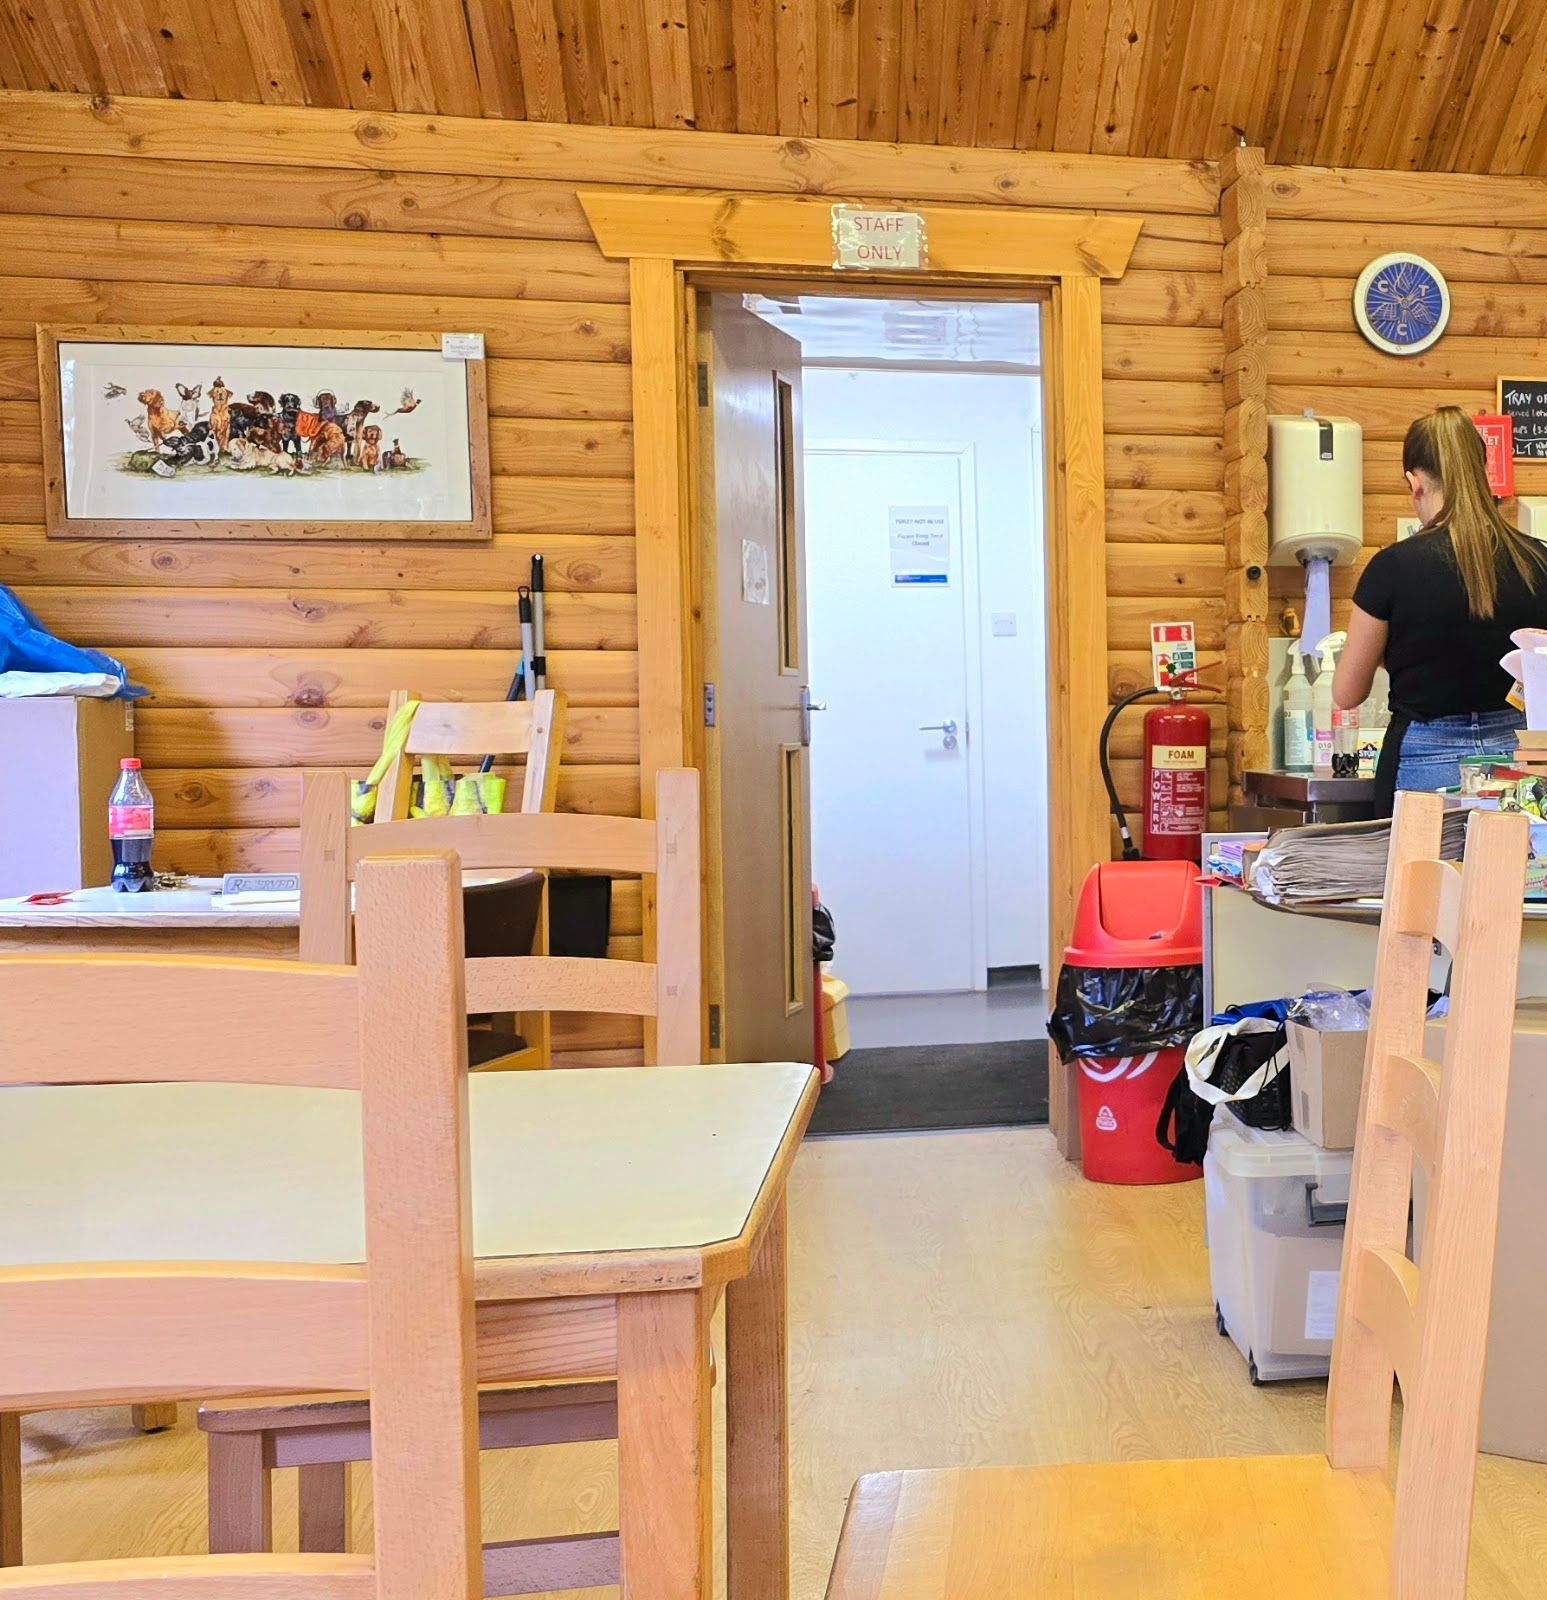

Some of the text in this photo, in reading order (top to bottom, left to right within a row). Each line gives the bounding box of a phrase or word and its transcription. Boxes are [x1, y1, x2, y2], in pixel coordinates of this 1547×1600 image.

[854, 217, 903, 232] STAFF
[857, 245, 902, 260] ONLY
[1505, 390, 1531, 405] TRAY
[1168, 751, 1194, 759] FOAM
